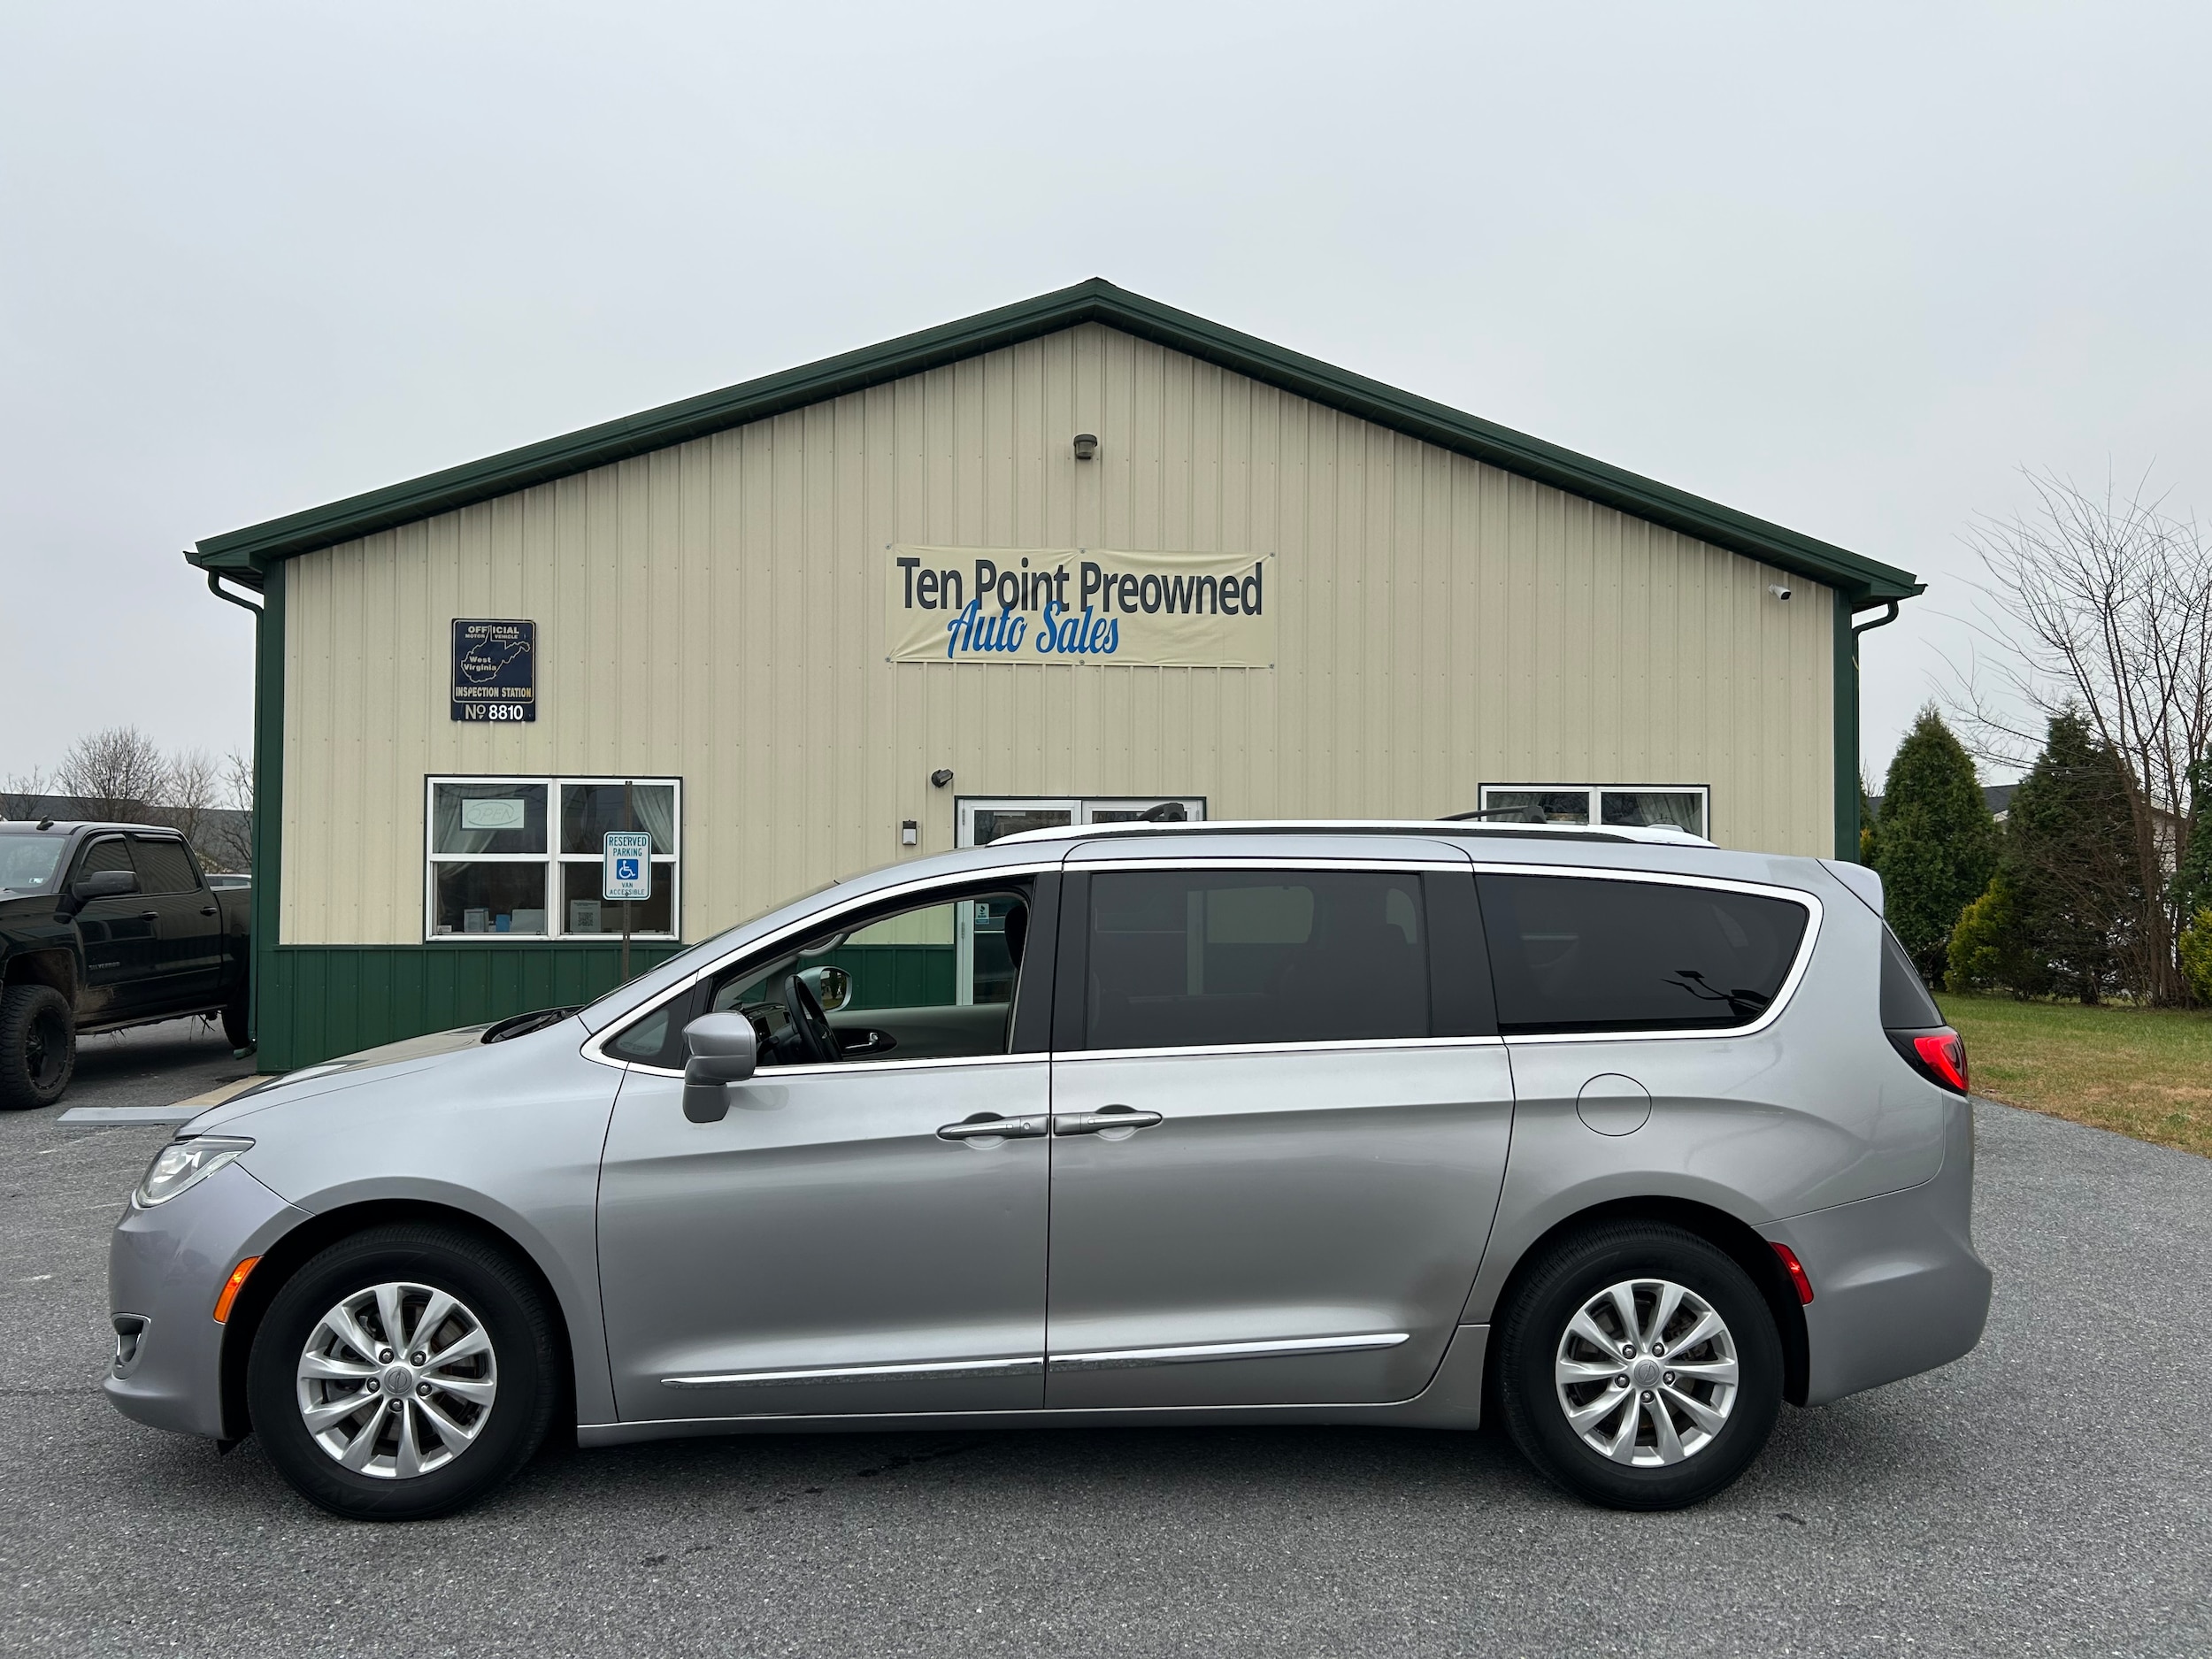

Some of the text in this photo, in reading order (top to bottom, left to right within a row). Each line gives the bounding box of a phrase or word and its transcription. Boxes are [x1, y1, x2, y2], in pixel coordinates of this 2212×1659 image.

[896, 557, 1263, 616] Ten Point Preowned
[948, 599, 1119, 658] Auto Sales
[456, 687, 532, 698] INSPECTION STATION
[488, 704, 524, 720] 8810
[466, 807, 514, 822] OPEN
[609, 836, 647, 847] RESERVED
[612, 848, 642, 856] PARKING
